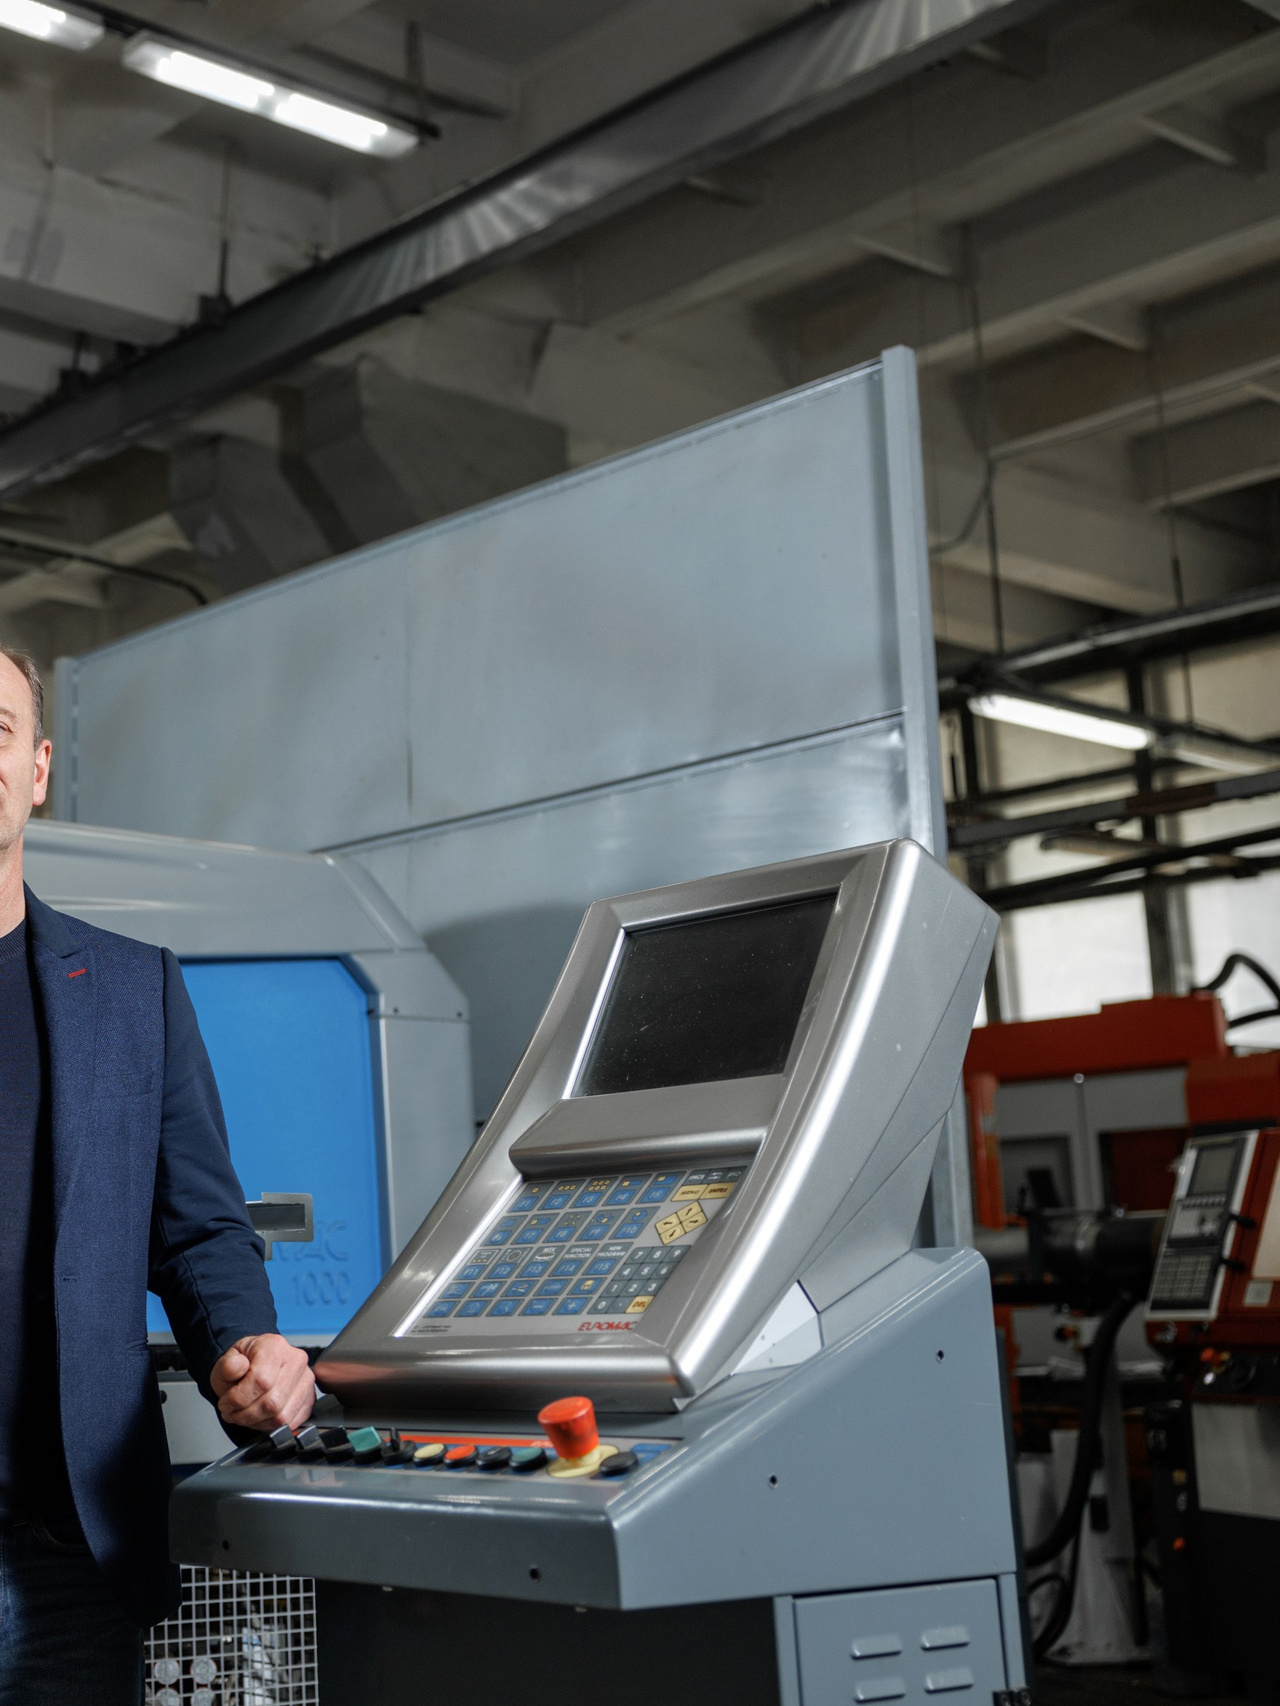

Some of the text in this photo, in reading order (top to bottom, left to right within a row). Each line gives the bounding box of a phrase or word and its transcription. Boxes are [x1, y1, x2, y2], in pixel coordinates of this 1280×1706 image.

[617, 1193, 630, 1201] F4
[649, 1191, 661, 1199] F5
[550, 1198, 562, 1206] F2
[523, 1231, 536, 1239] F7
[555, 1230, 568, 1238] F8
[588, 1227, 601, 1236] F9
[634, 1251, 644, 1259] 7
[653, 1250, 662, 1259] 8
[673, 1249, 681, 1258] 9
[622, 1267, 632, 1276] 4
[641, 1267, 651, 1275] 5
[660, 1266, 669, 1275] 6
[292, 1271, 351, 1307] 1000
[611, 1284, 618, 1292] 1
[628, 1283, 638, 1292] 2
[647, 1283, 657, 1292] 3
[597, 1301, 606, 1310] 0
[577, 1321, 638, 1331] EUROMAC
